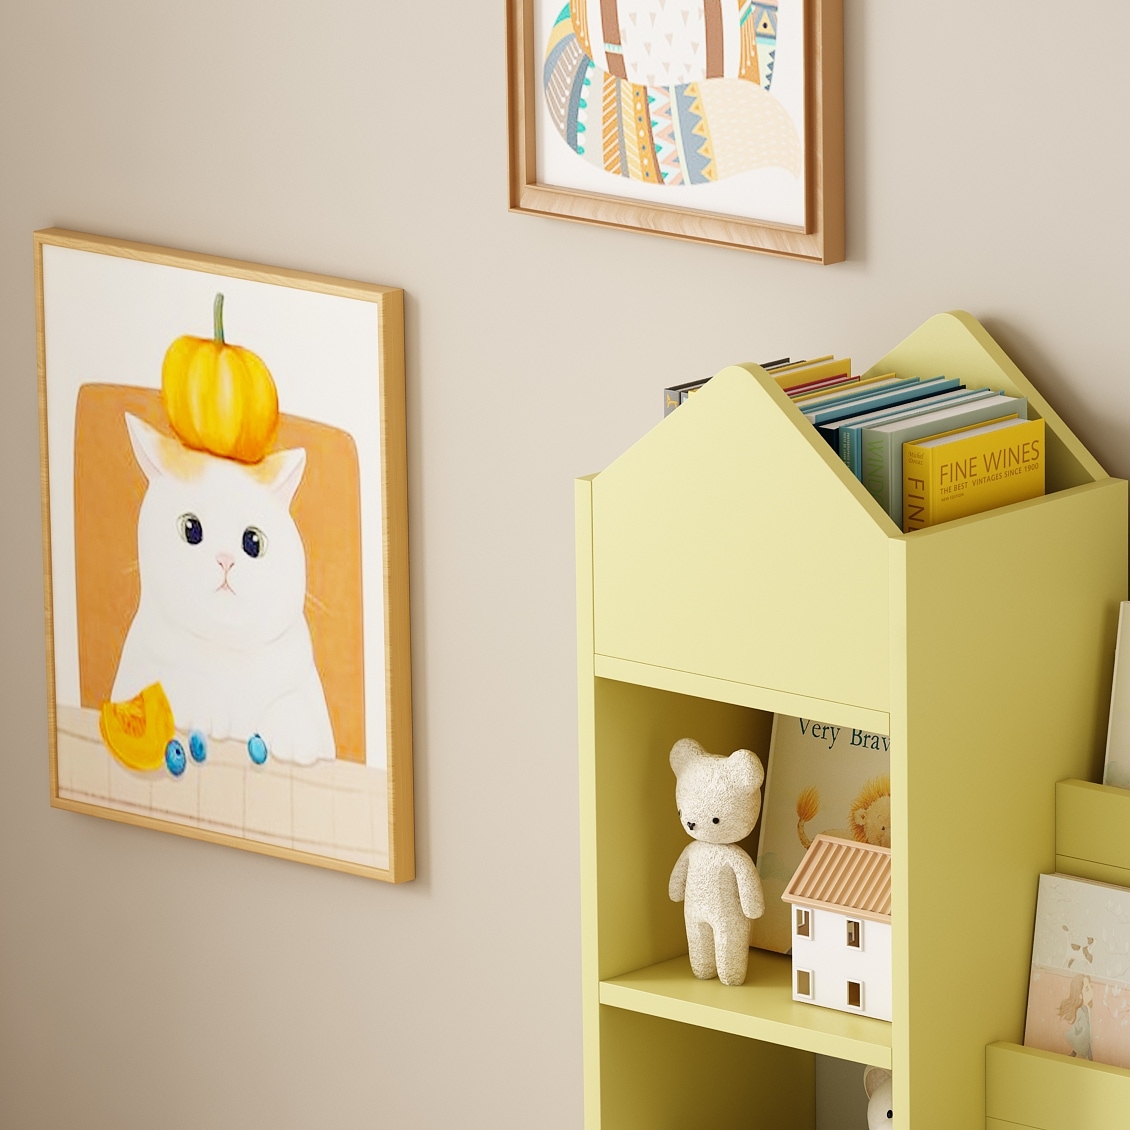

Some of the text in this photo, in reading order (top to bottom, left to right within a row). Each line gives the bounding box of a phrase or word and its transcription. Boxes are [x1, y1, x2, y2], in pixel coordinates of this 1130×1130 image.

[940, 440, 1040, 486] FINE WINES
[940, 462, 1040, 496] THE BEST VINTAGES SINCE 1900
[798, 717, 890, 752] Very Brav
